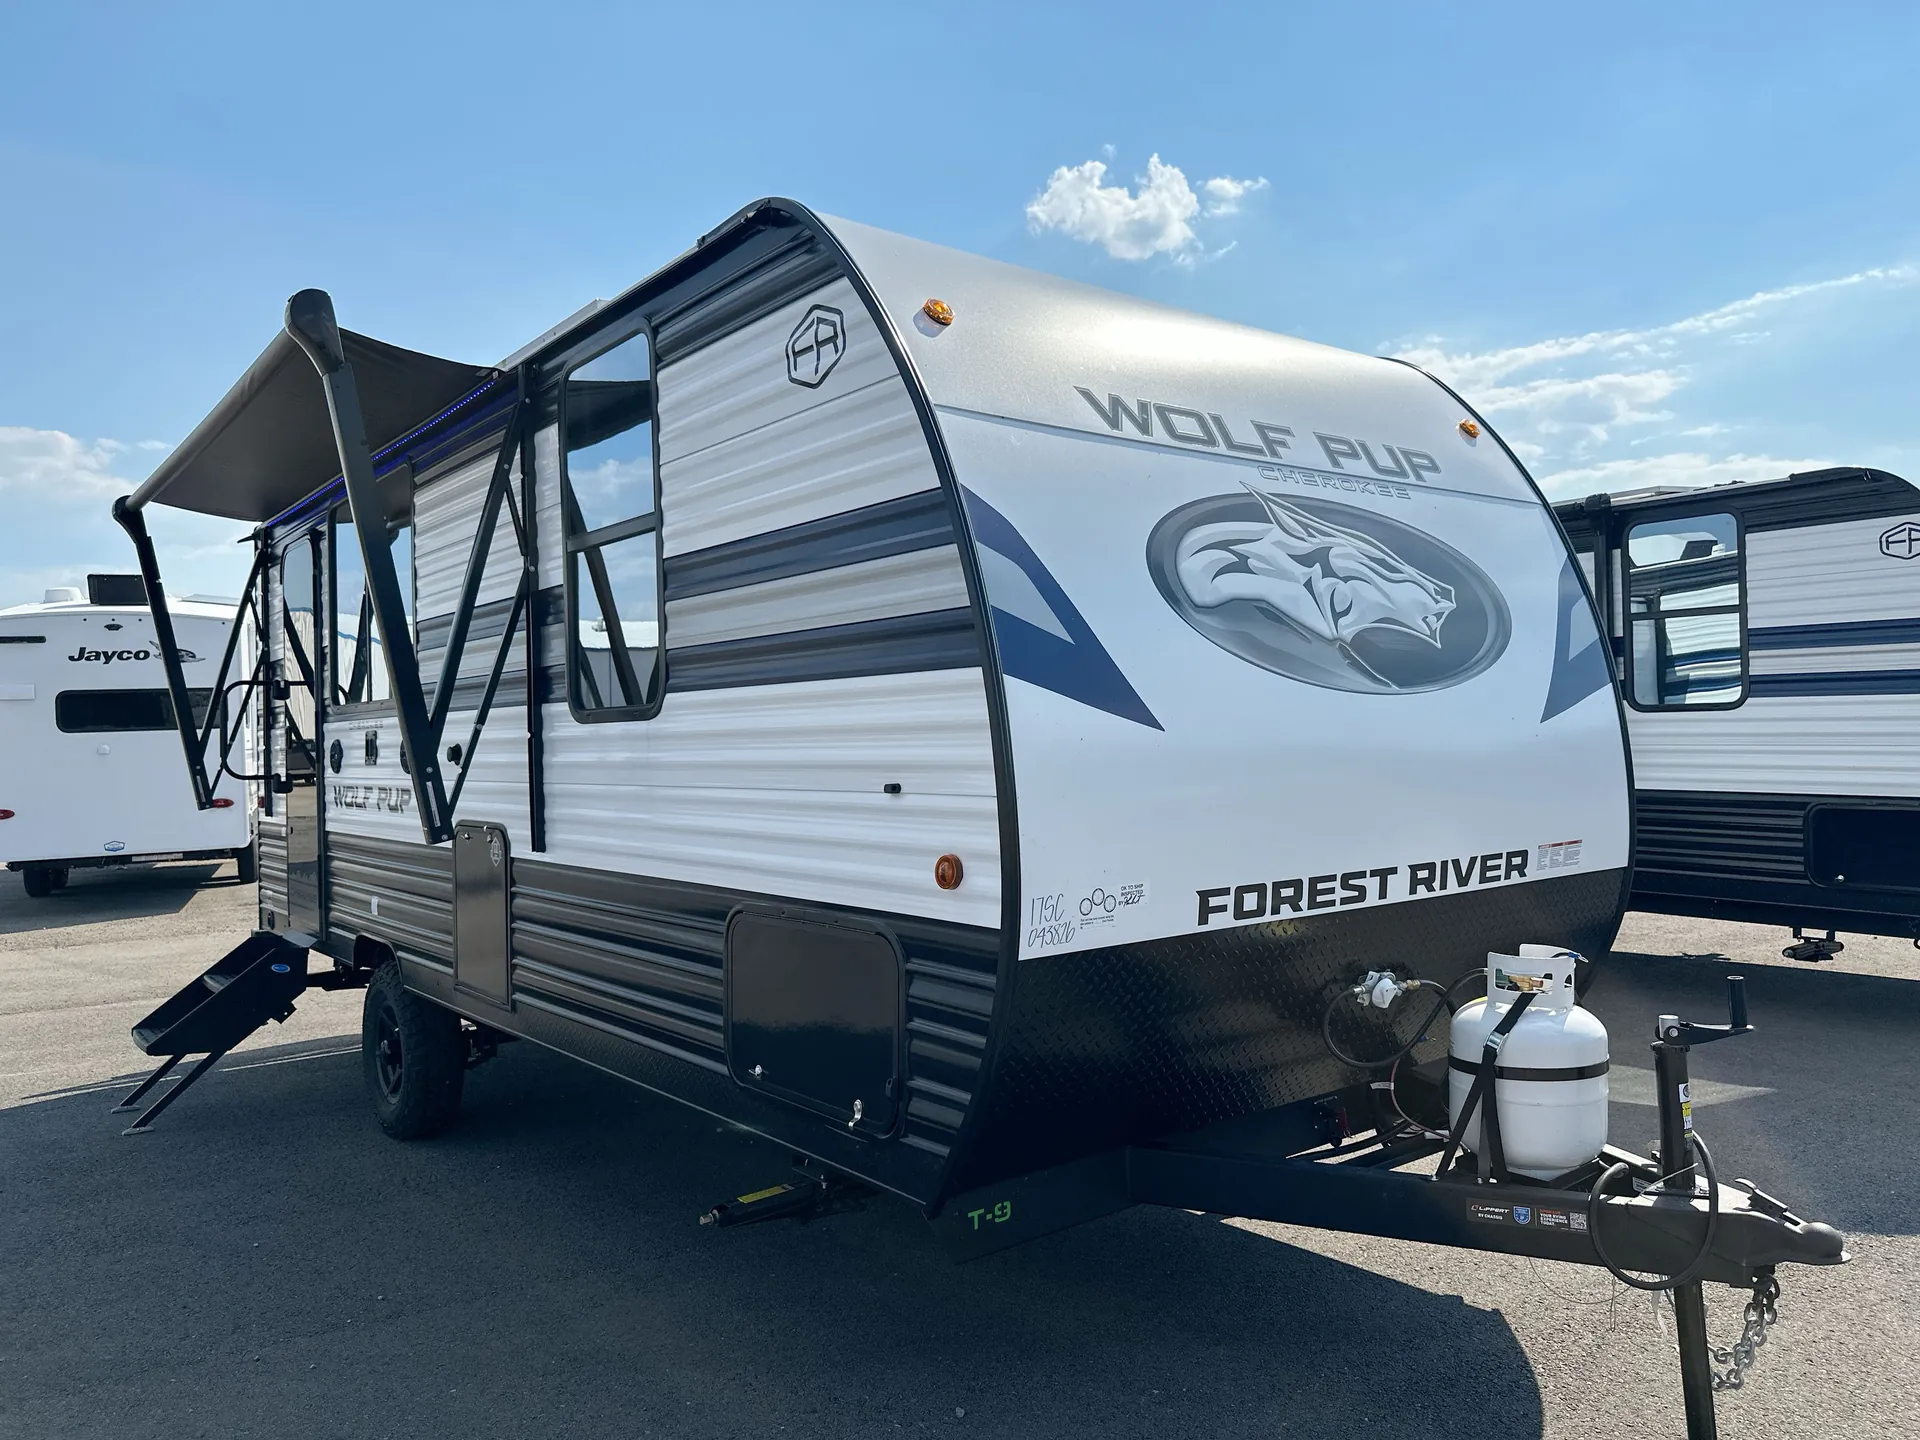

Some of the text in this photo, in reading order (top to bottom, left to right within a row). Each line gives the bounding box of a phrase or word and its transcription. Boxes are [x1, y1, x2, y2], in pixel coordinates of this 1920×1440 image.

[1073, 385, 1442, 483] WOLF PUP
[1257, 465, 1412, 500] CHEROKEE
[68, 646, 151, 665] Jayco
[333, 785, 374, 809] WOLF
[376, 786, 412, 814] PUP
[1195, 866, 1399, 927] FOREST
[1407, 849, 1530, 896] RIVER
[1027, 920, 1076, 949] 043826
[967, 1200, 1012, 1230] T-9
